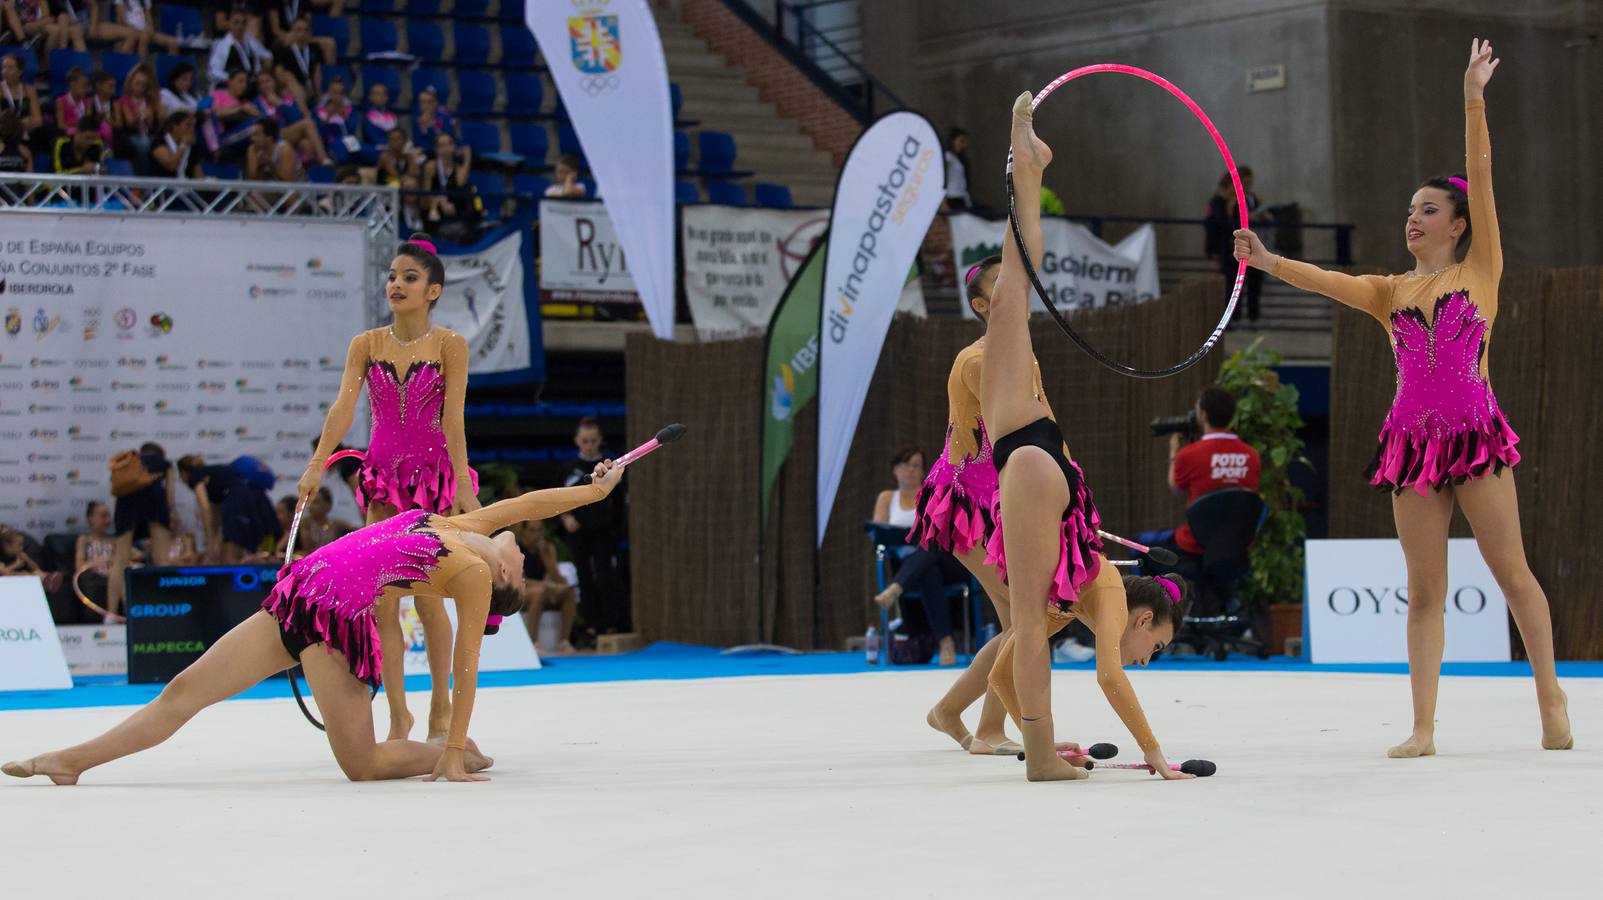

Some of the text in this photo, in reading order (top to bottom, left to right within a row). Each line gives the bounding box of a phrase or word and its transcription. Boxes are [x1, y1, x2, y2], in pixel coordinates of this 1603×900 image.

[892, 148, 935, 226] seguros
[7, 240, 25, 254] DE
[829, 135, 921, 345] divinapastora
[9, 283, 74, 295] IBERDROLA
[1211, 453, 1247, 467] FOTO
[1211, 466, 1249, 479] SPORT
[159, 576, 206, 587] JUNIOR
[1328, 585, 1487, 616] OYSO
[130, 602, 192, 617] GROUP
[133, 640, 205, 653] MAPECCA
